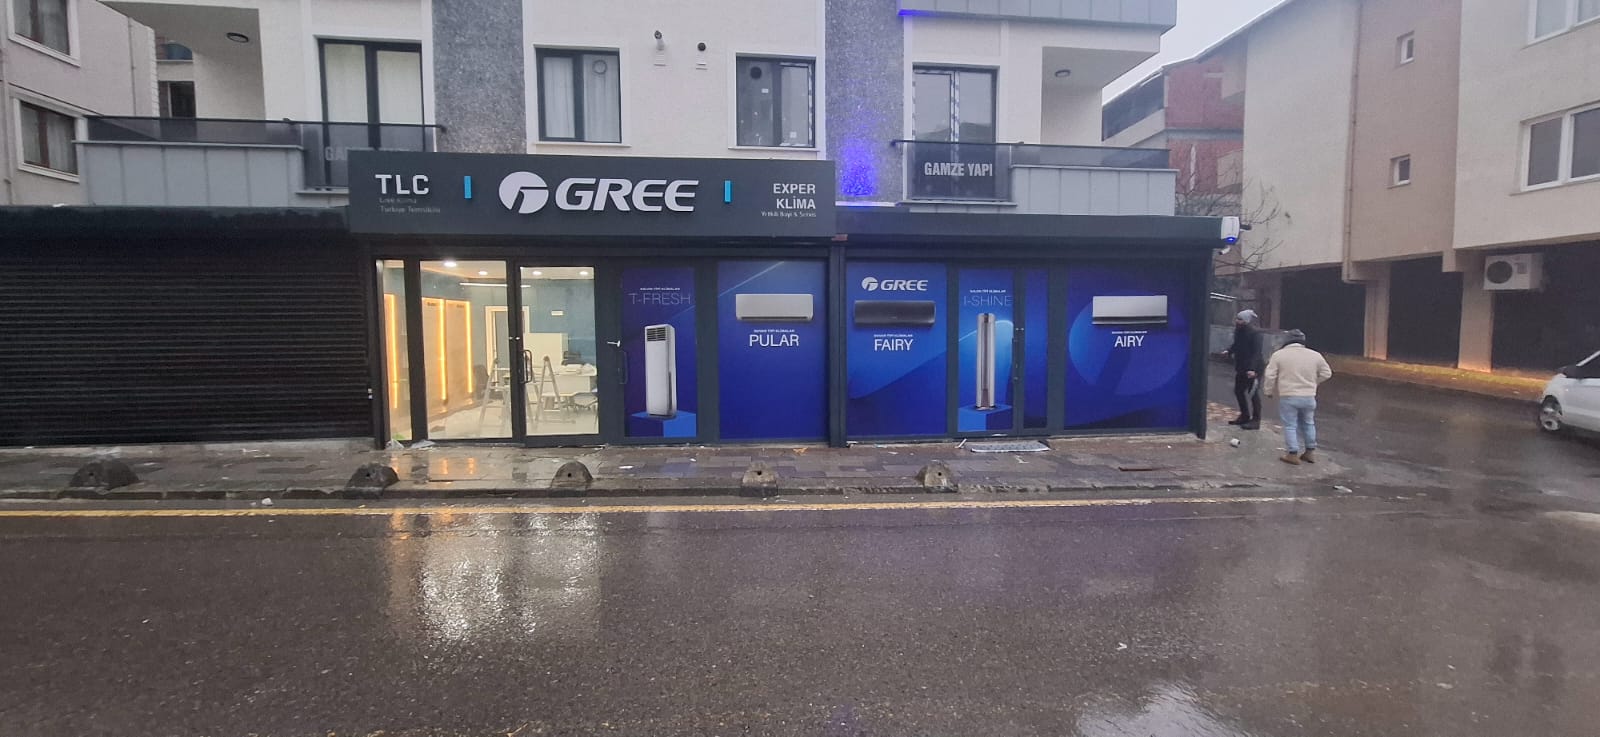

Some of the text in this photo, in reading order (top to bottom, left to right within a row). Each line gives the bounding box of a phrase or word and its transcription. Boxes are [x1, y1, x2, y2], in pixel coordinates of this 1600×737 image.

[924, 162, 993, 177] GAMZE YAPI
[374, 174, 430, 195] TLC
[773, 183, 816, 194] EXPER
[555, 177, 699, 213] GREE
[776, 196, 817, 209] KLİMA
[880, 279, 929, 292] GREE
[627, 292, 692, 305] T-FRESH
[963, 295, 1013, 306] I-SHINE
[749, 334, 799, 347] PULAR
[874, 338, 914, 351] FAIRY
[1114, 335, 1145, 348] AIRY
